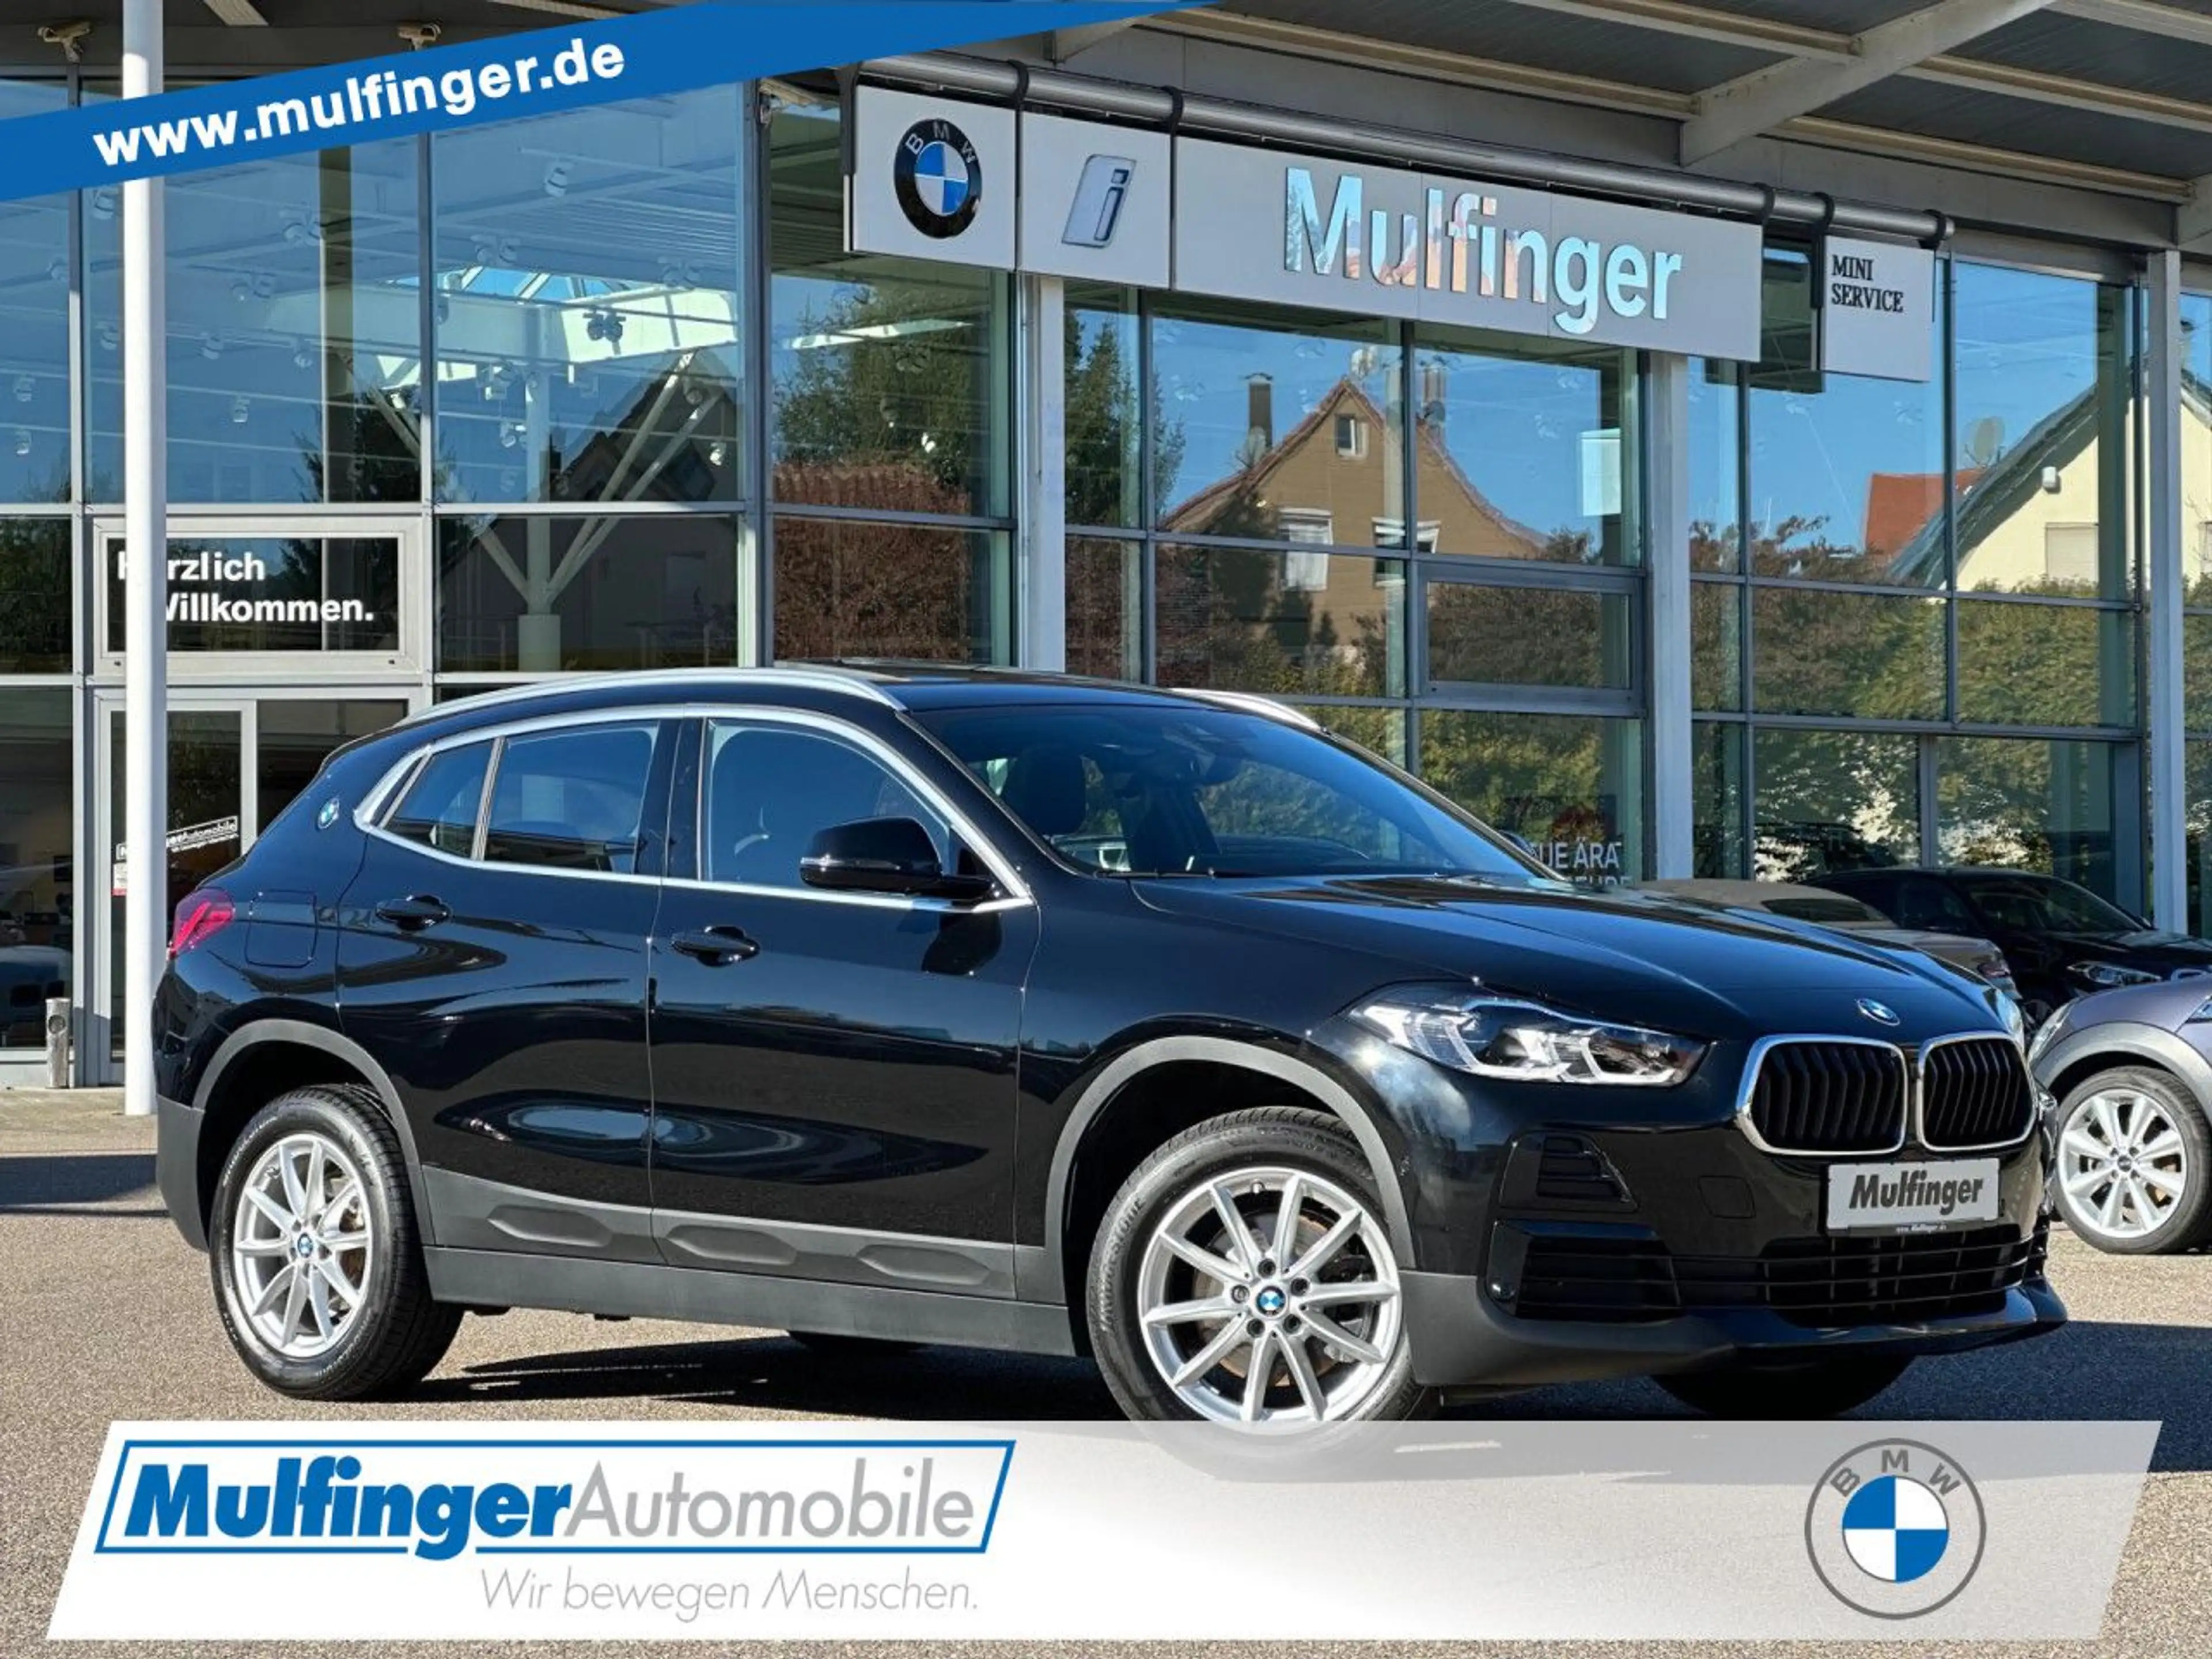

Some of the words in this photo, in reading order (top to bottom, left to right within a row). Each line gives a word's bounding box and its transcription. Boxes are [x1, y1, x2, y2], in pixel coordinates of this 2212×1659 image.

[905, 122, 977, 164] BMW
[1284, 167, 1683, 335] Mulfinger
[1832, 254, 1873, 281] MINI
[1832, 282, 1904, 313] SERVICE
[118, 551, 265, 581] rzlich
[1849, 1170, 1984, 1215] Mulfinger
